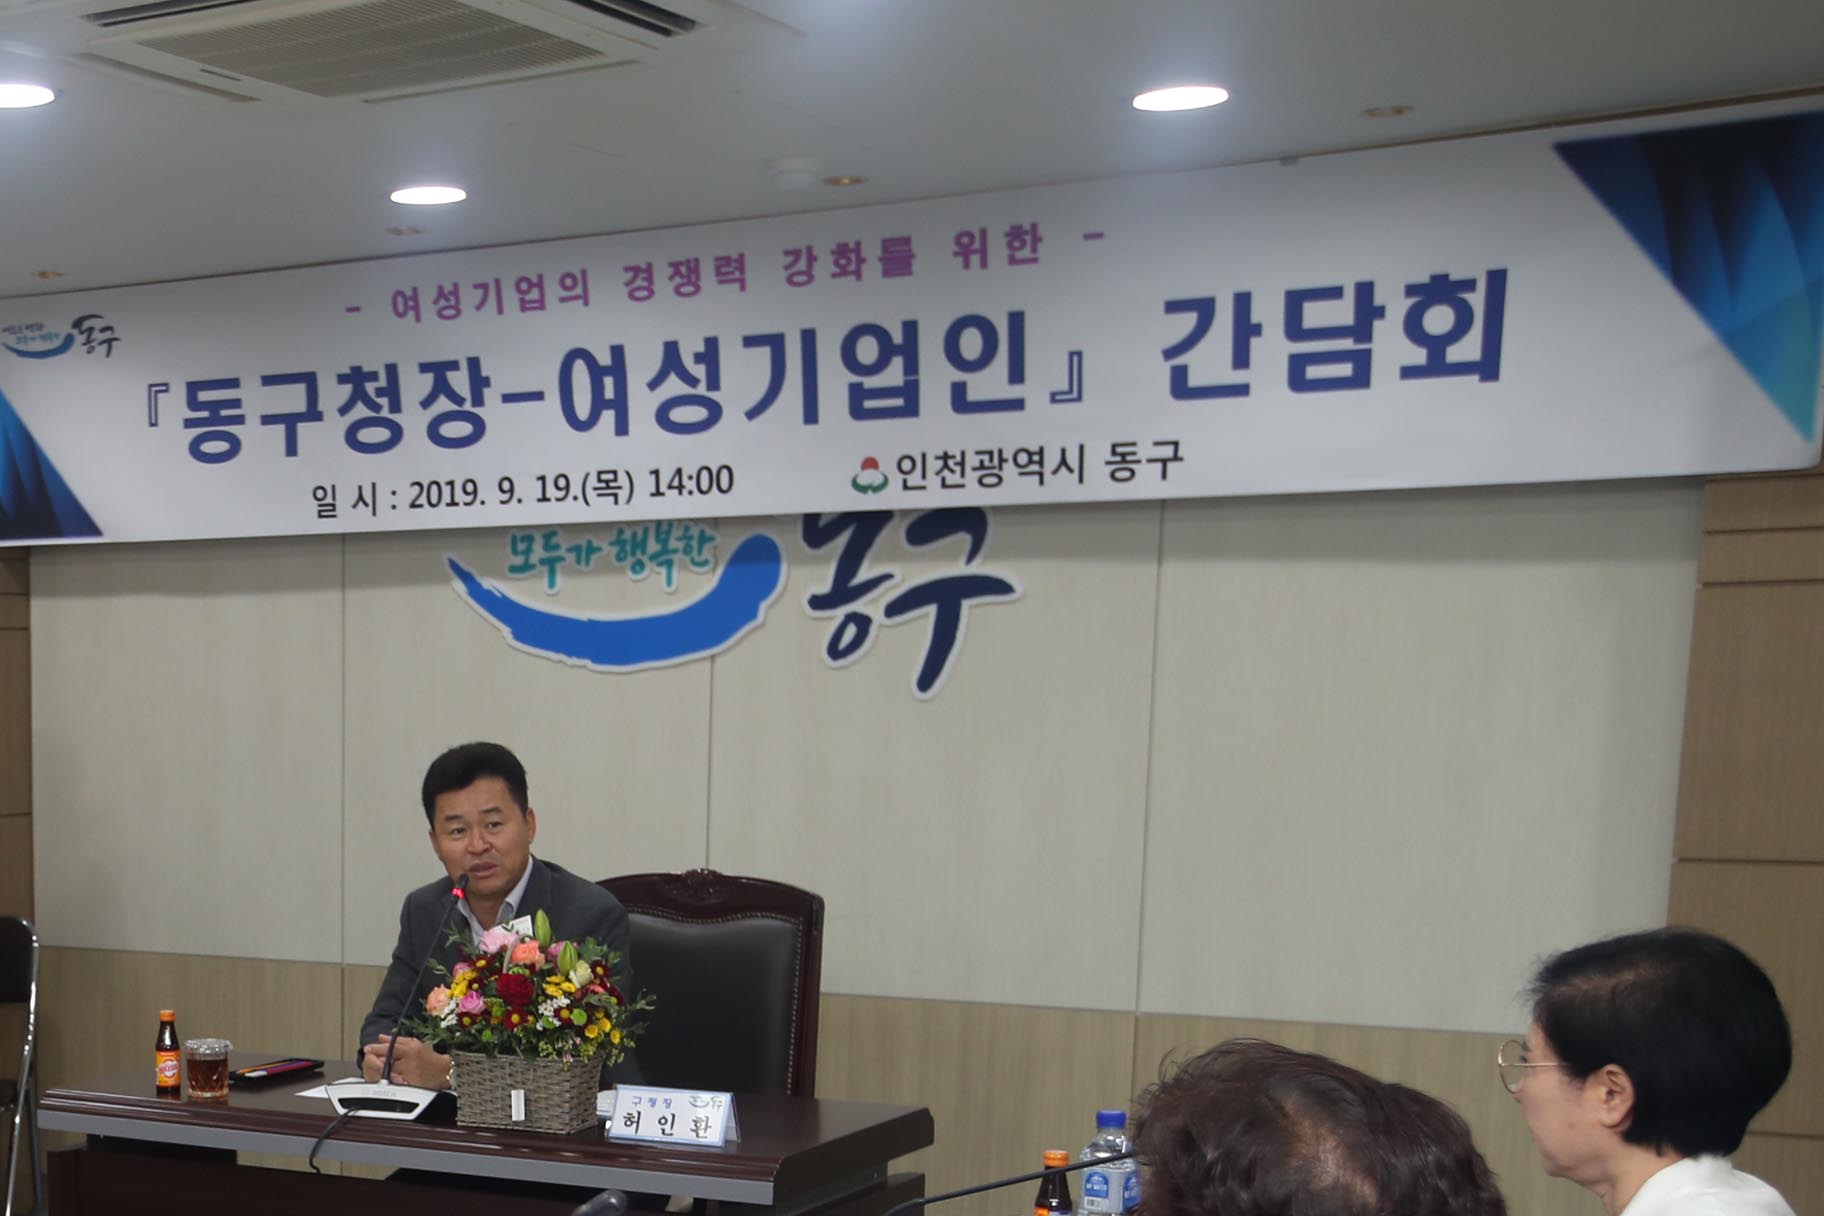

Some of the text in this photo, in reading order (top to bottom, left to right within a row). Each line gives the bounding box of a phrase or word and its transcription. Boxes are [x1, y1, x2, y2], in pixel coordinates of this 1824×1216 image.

[390, 268, 591, 324] 여성기업의
[622, 252, 749, 303] 경쟁력
[783, 235, 916, 288] 강화를
[951, 221, 1044, 271] 위한
[1159, 267, 1509, 402] 간담회
[408, 479, 486, 510] 2019.
[648, 464, 735, 498] 14:00
[894, 438, 1186, 494] 인천광역시 동구
[507, 520, 717, 590] 모두가 행복한
